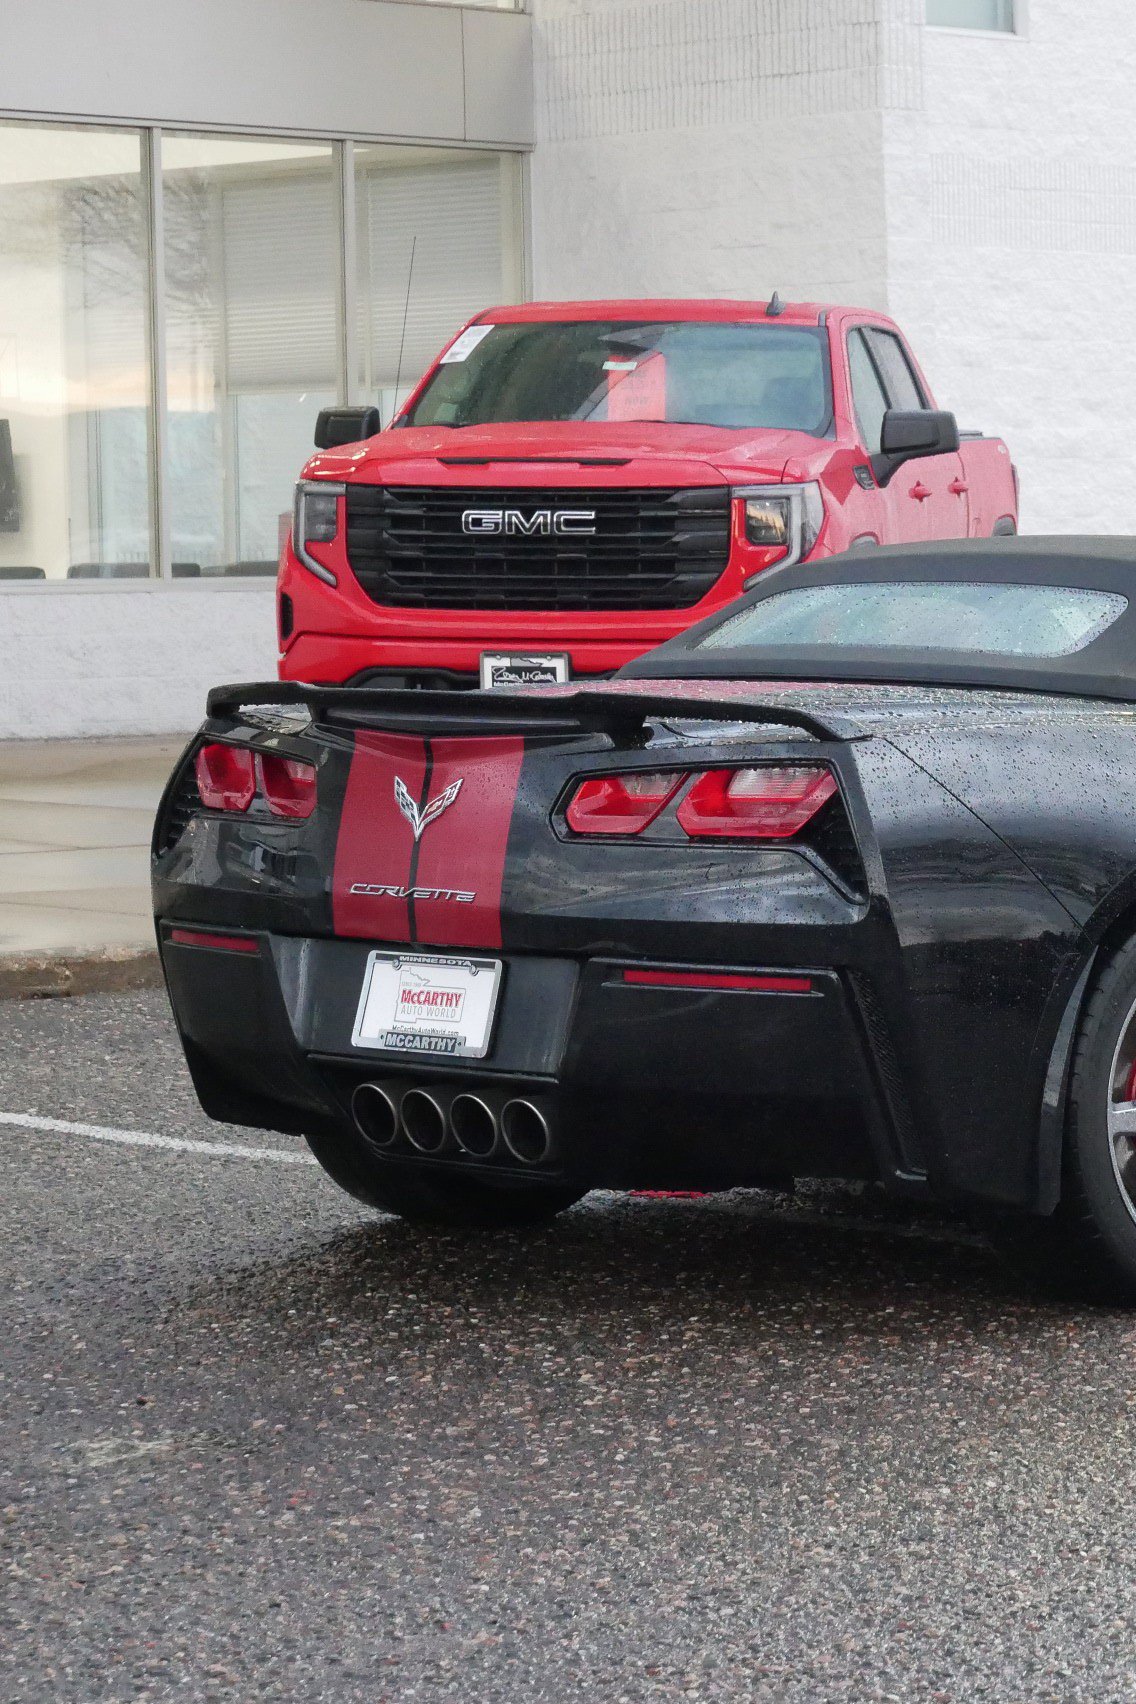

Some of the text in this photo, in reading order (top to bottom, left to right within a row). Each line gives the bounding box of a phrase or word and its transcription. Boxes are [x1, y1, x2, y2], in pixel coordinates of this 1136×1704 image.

[462, 510, 596, 535] GMC
[350, 883, 476, 902] CORVETTE
[400, 956, 472, 967] MINNESOTA
[401, 988, 462, 1008] McCARTHY
[401, 1005, 456, 1018] AUTO WORLD
[392, 1025, 460, 1036] McCarthyAutoWorld.com
[385, 1033, 456, 1051] MCCARTHY
